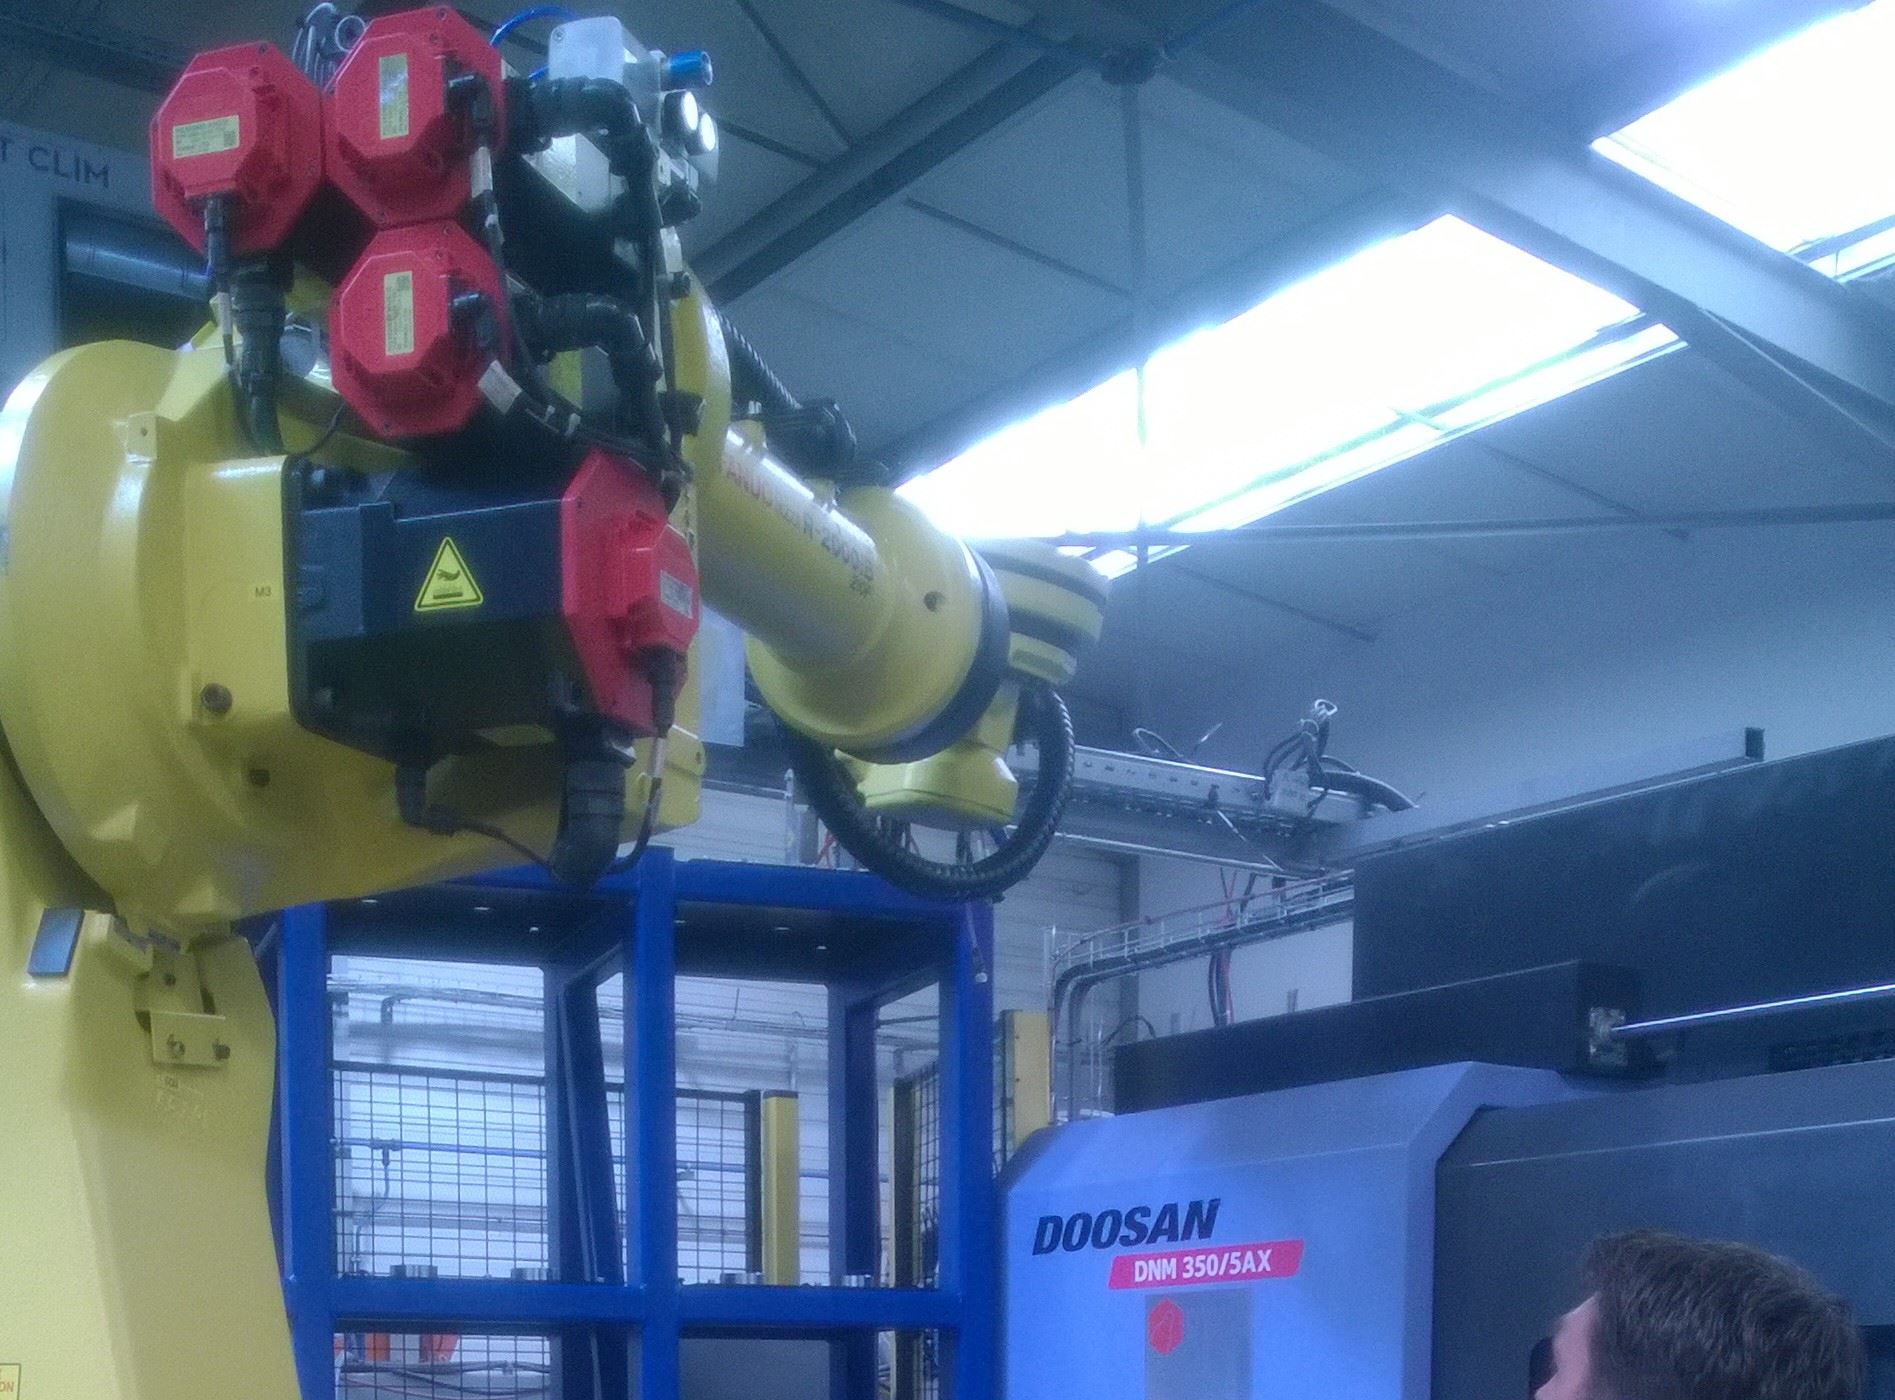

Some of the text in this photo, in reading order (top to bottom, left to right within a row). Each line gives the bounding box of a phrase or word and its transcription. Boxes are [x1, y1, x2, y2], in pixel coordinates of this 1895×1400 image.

[29, 144, 109, 189] CLIM
[1032, 1197, 1221, 1256] DOOSAN
[1134, 1248, 1273, 1283] DNM 350/5AX
